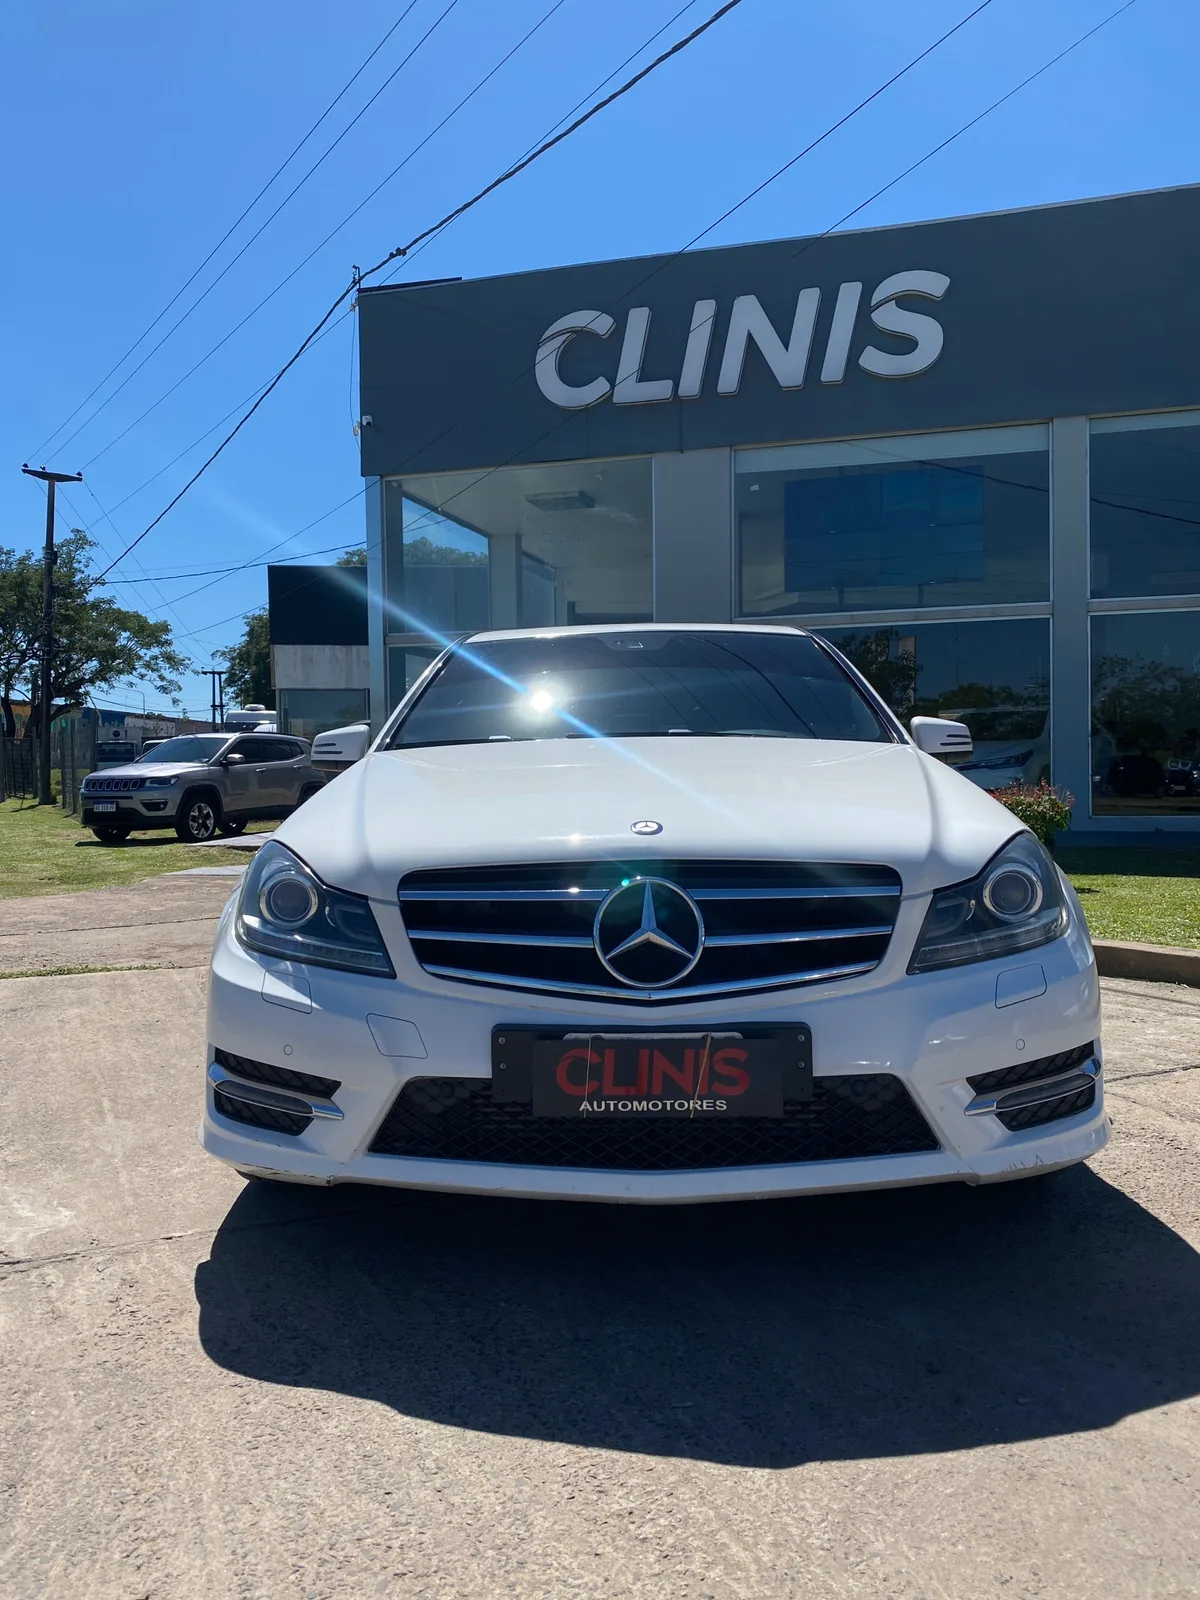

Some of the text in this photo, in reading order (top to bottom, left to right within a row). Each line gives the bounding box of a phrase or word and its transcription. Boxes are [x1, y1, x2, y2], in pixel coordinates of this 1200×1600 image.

[535, 269, 951, 409] CLINIS
[556, 1048, 751, 1096] CLINIS
[578, 1099, 728, 1112] AUTOMOTORES
